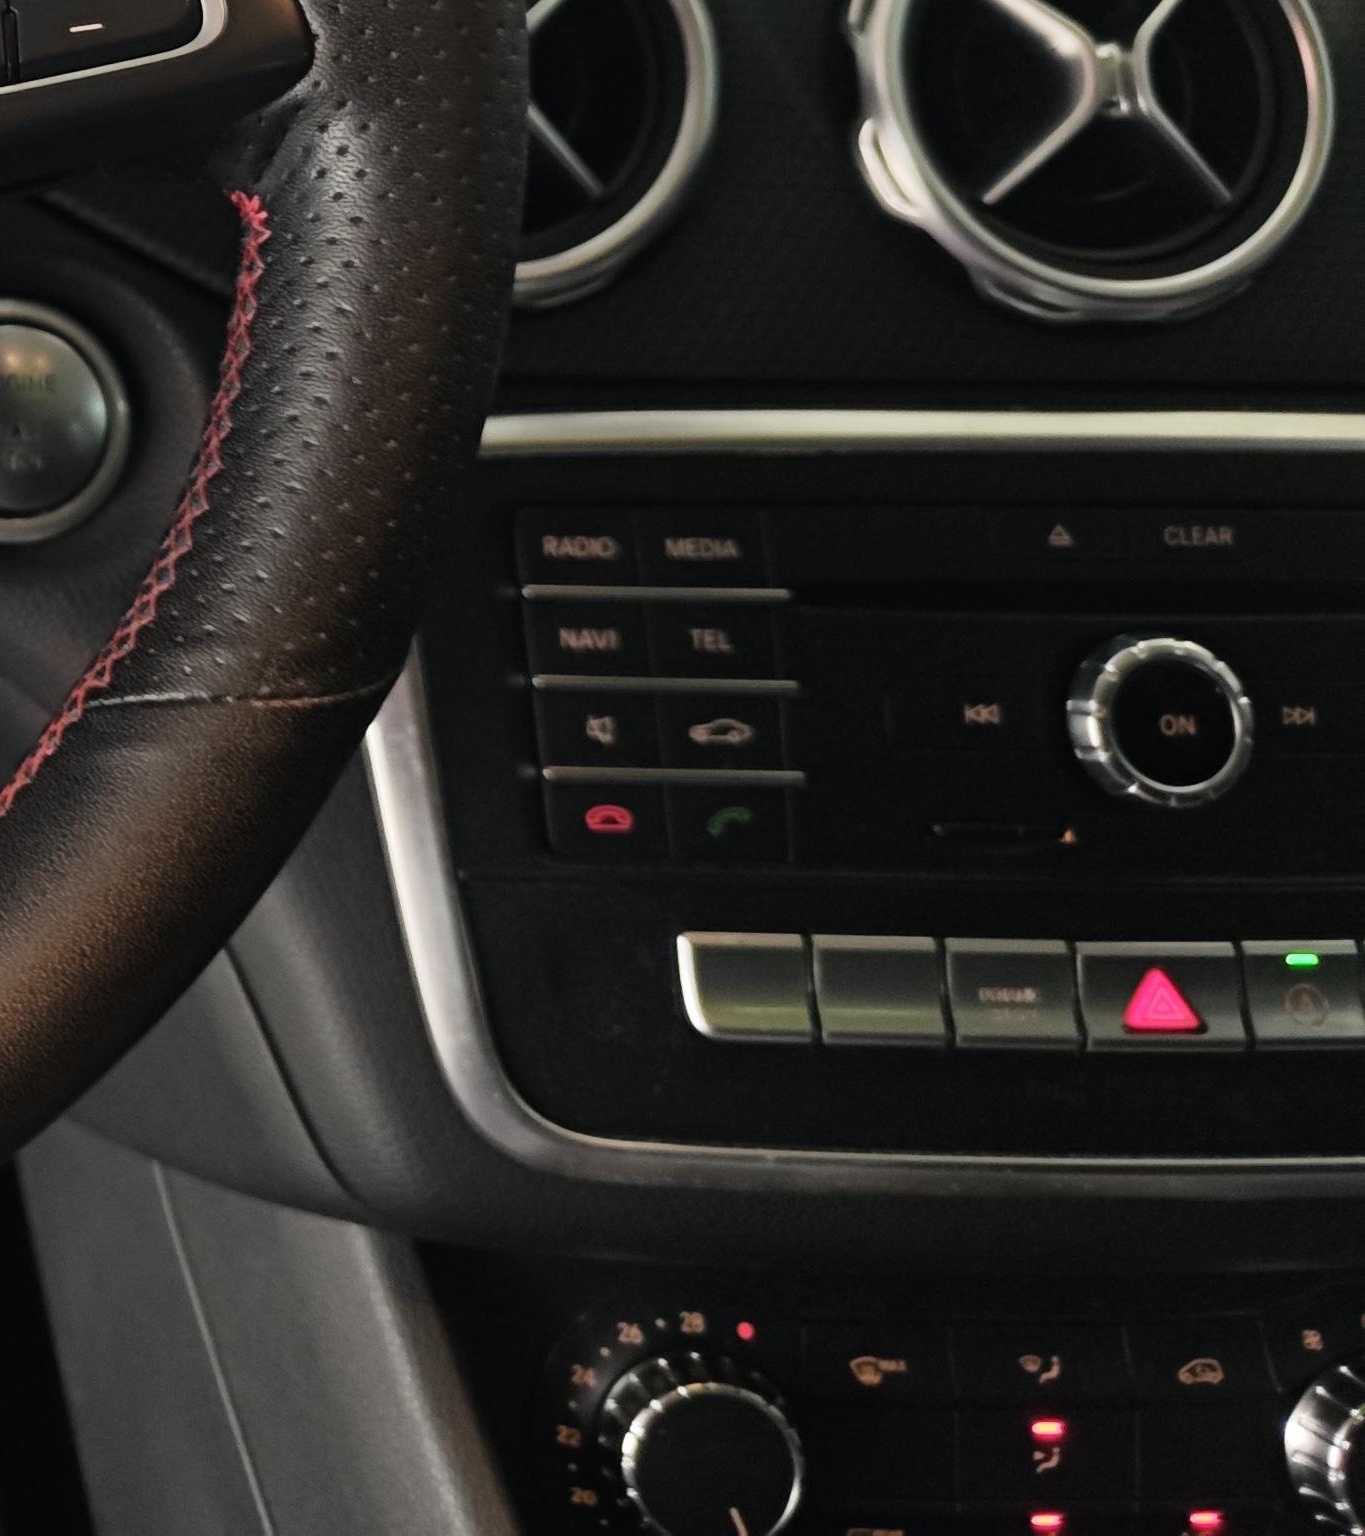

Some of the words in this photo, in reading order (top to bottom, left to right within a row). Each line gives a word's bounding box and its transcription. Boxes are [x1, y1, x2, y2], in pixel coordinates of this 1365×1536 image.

[1163, 525, 1235, 546] CLEAR
[542, 535, 618, 560] RADIO
[665, 537, 739, 559] MEDIA
[559, 628, 619, 650] NAVI
[689, 628, 732, 652] TEL
[1159, 713, 1197, 737] ON
